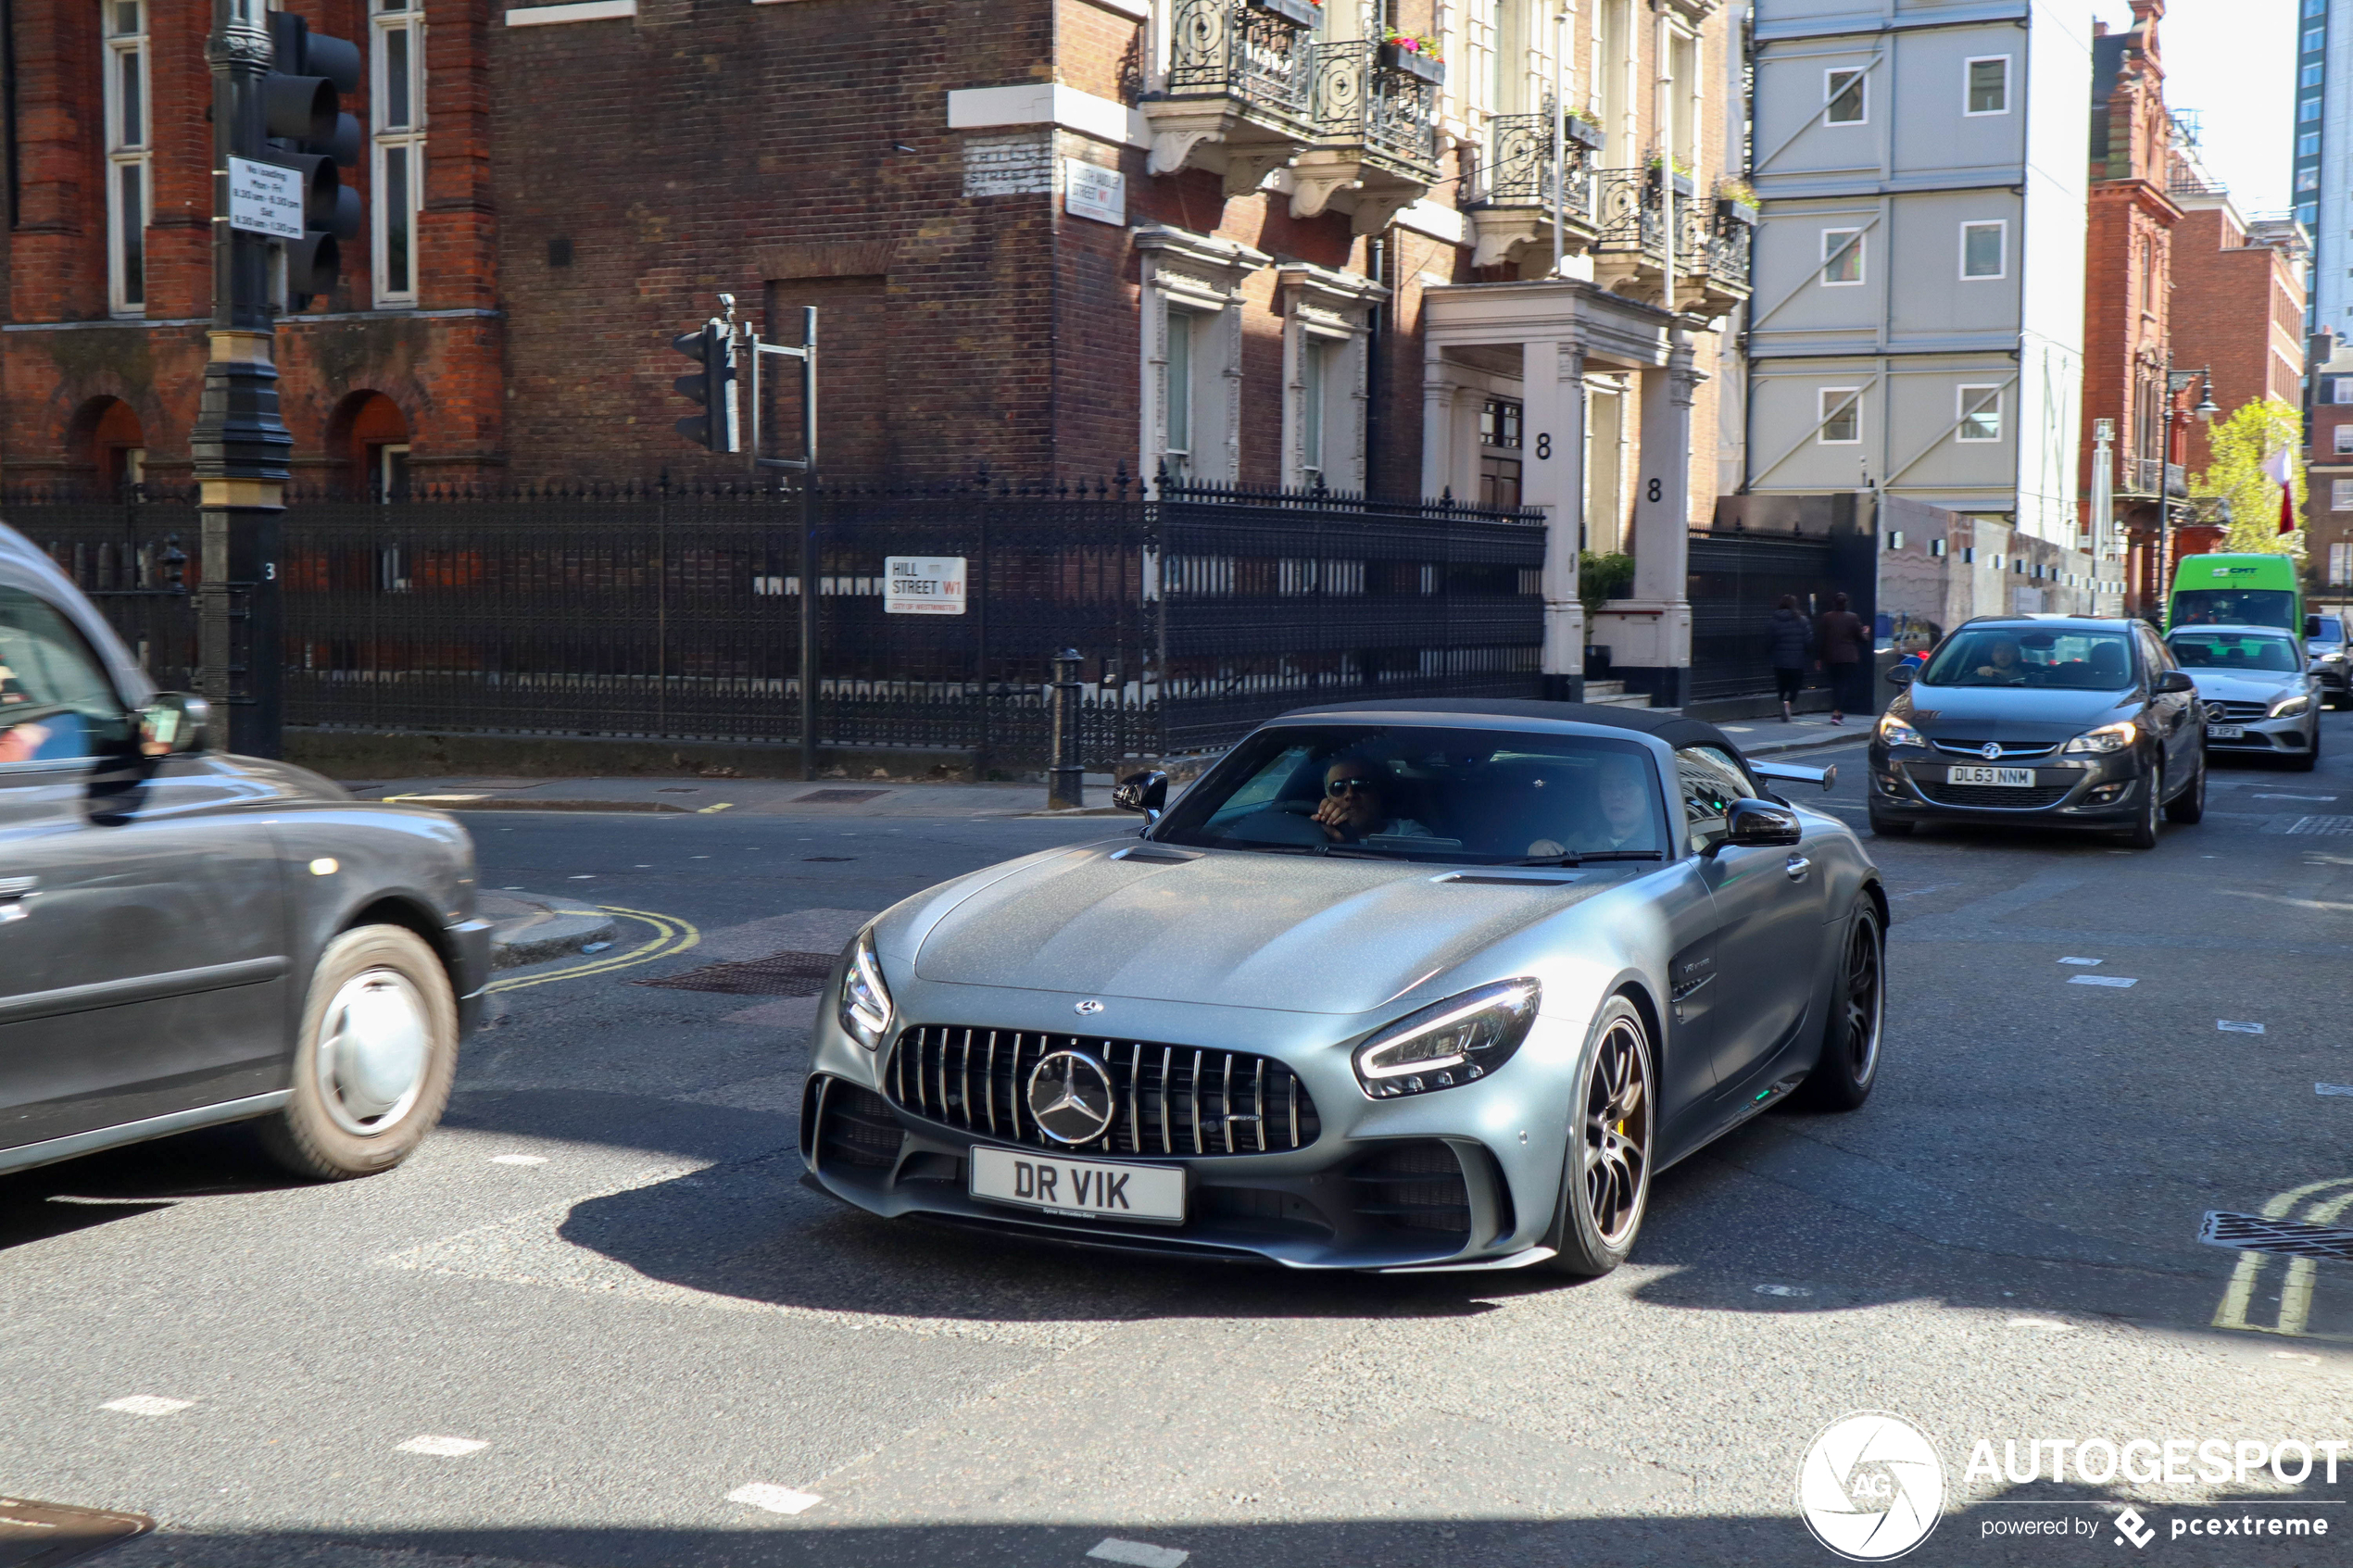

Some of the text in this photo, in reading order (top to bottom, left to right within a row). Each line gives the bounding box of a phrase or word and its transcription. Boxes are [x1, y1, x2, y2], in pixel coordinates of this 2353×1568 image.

[245, 164, 288, 182] No loading
[1072, 182, 1098, 201] STREET
[259, 207, 275, 218] Sat
[1537, 433, 1551, 460] 8
[1647, 477, 1662, 503] 8
[265, 562, 276, 581] 3
[892, 562, 918, 577] HILL
[892, 580, 962, 596] STREET W1
[2217, 727, 2236, 736] XPX
[1954, 767, 2028, 784] DL63 NNM
[1013, 1160, 1130, 1210] DR VIK
